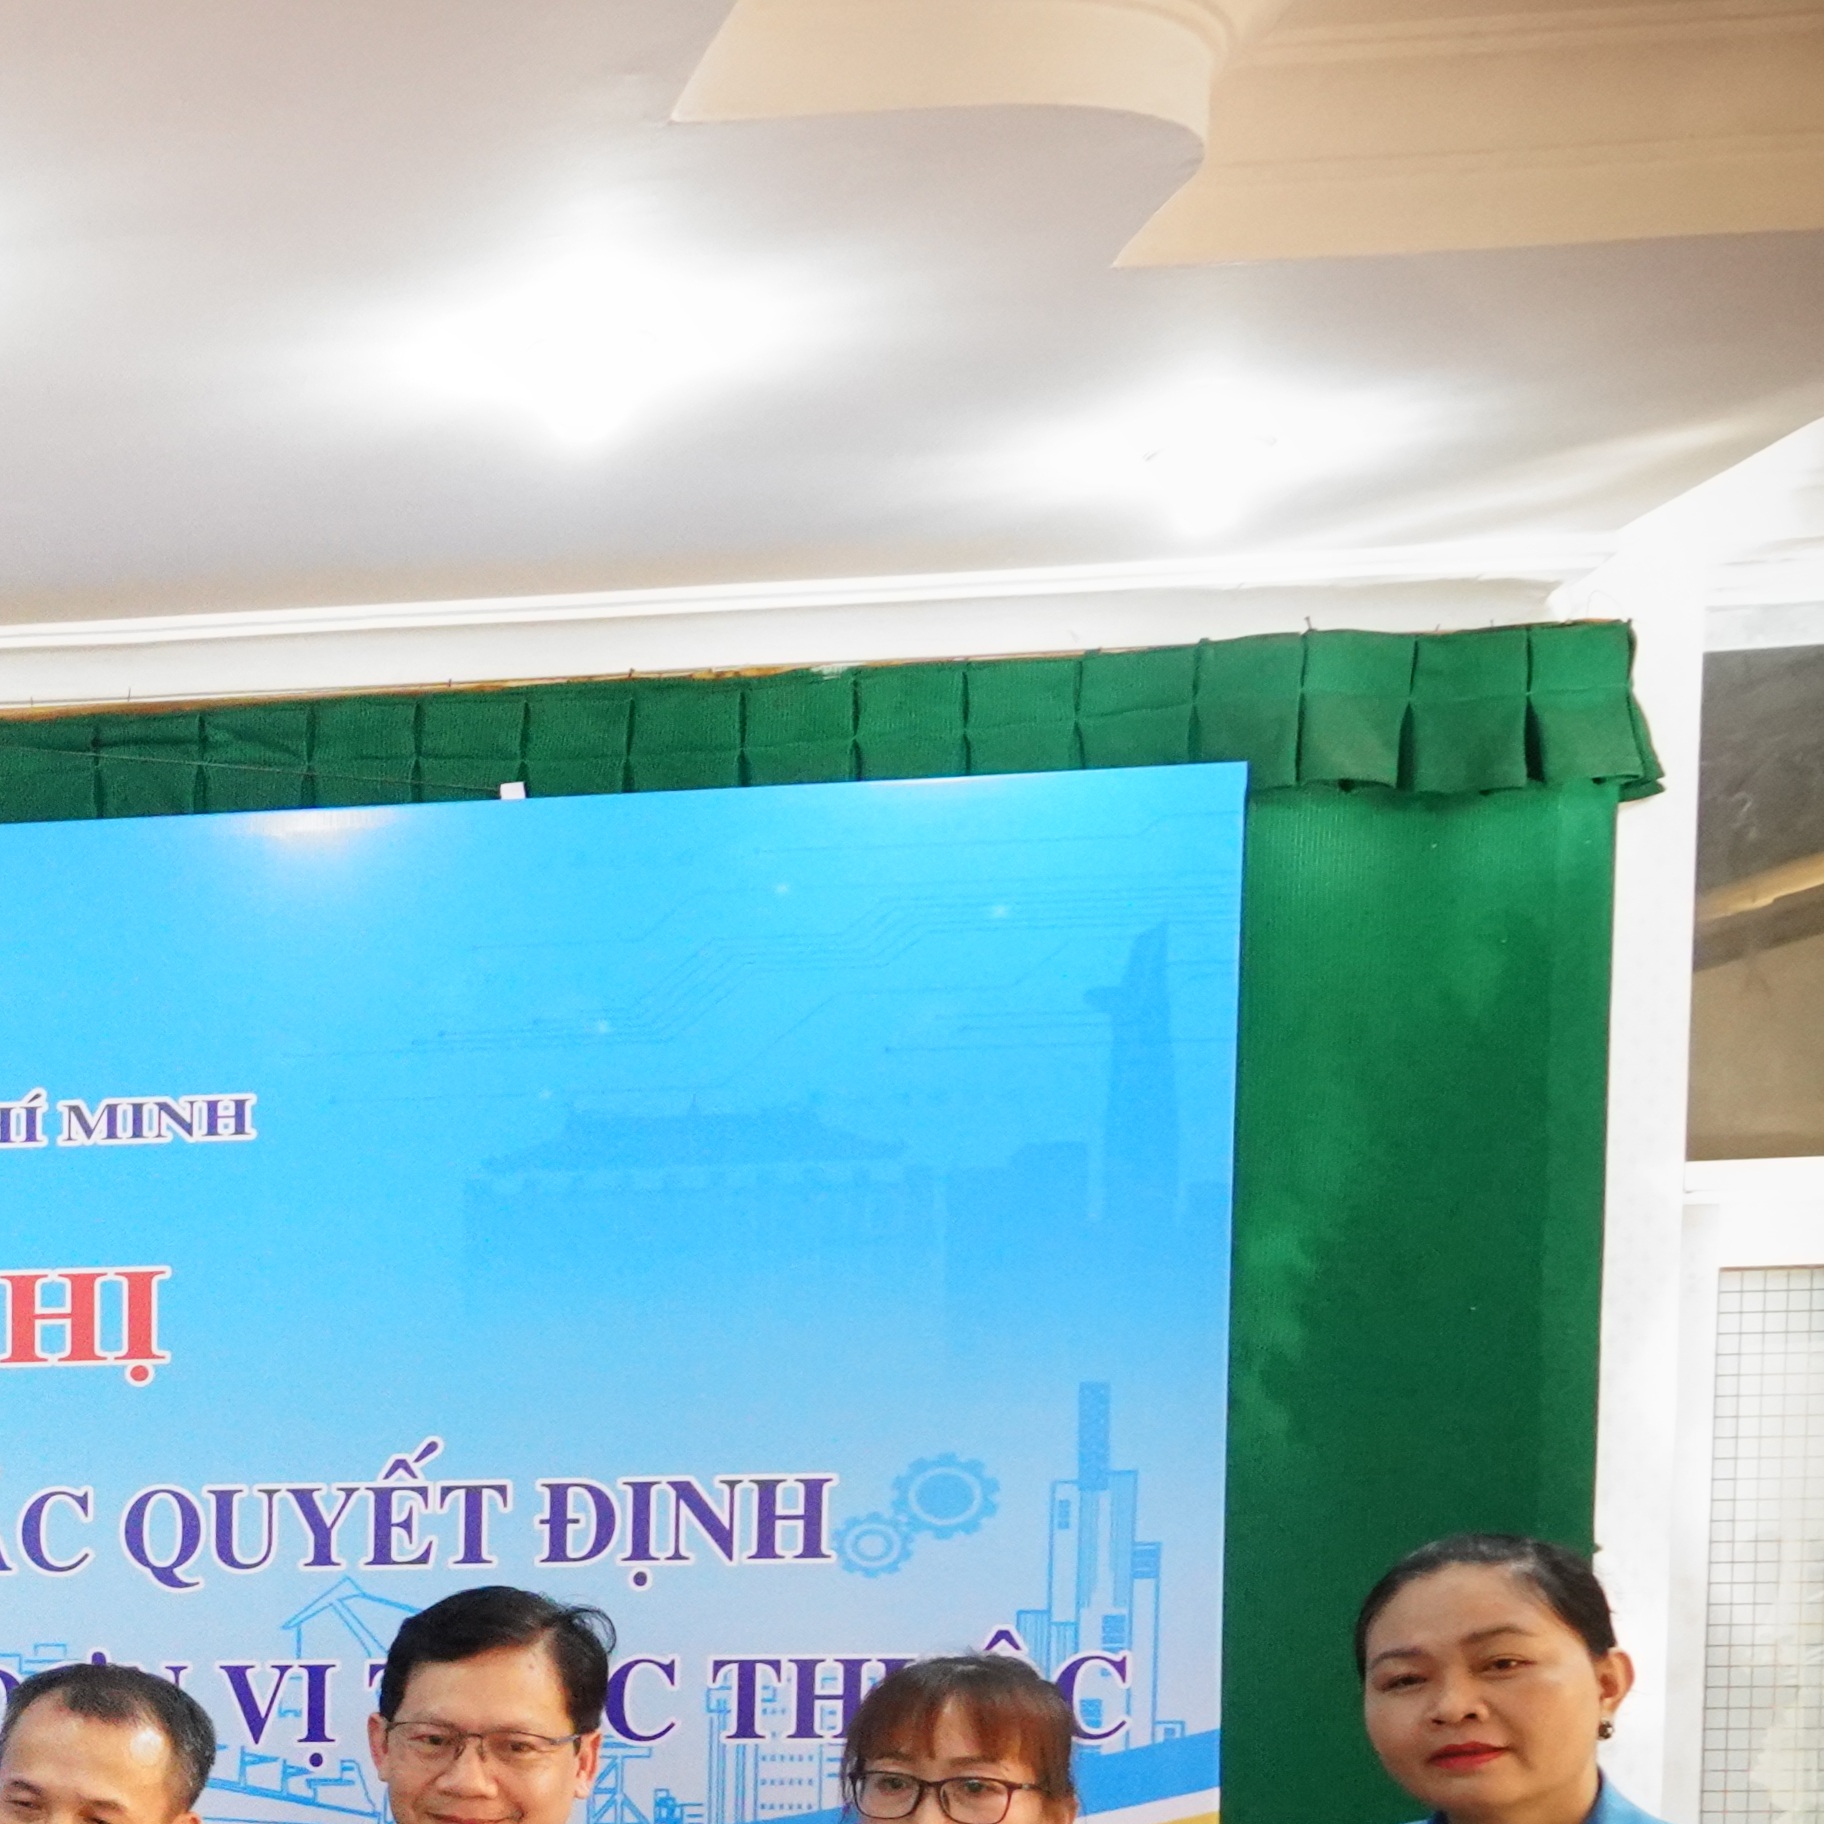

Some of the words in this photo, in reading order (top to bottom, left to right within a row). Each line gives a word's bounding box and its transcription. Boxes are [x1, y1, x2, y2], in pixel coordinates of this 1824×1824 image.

[60, 1097, 255, 1143] MINH
[122, 1440, 508, 1592] QUYẾT
[540, 1477, 837, 1589] ĐỊNH
[219, 1663, 338, 1768] VỊ
